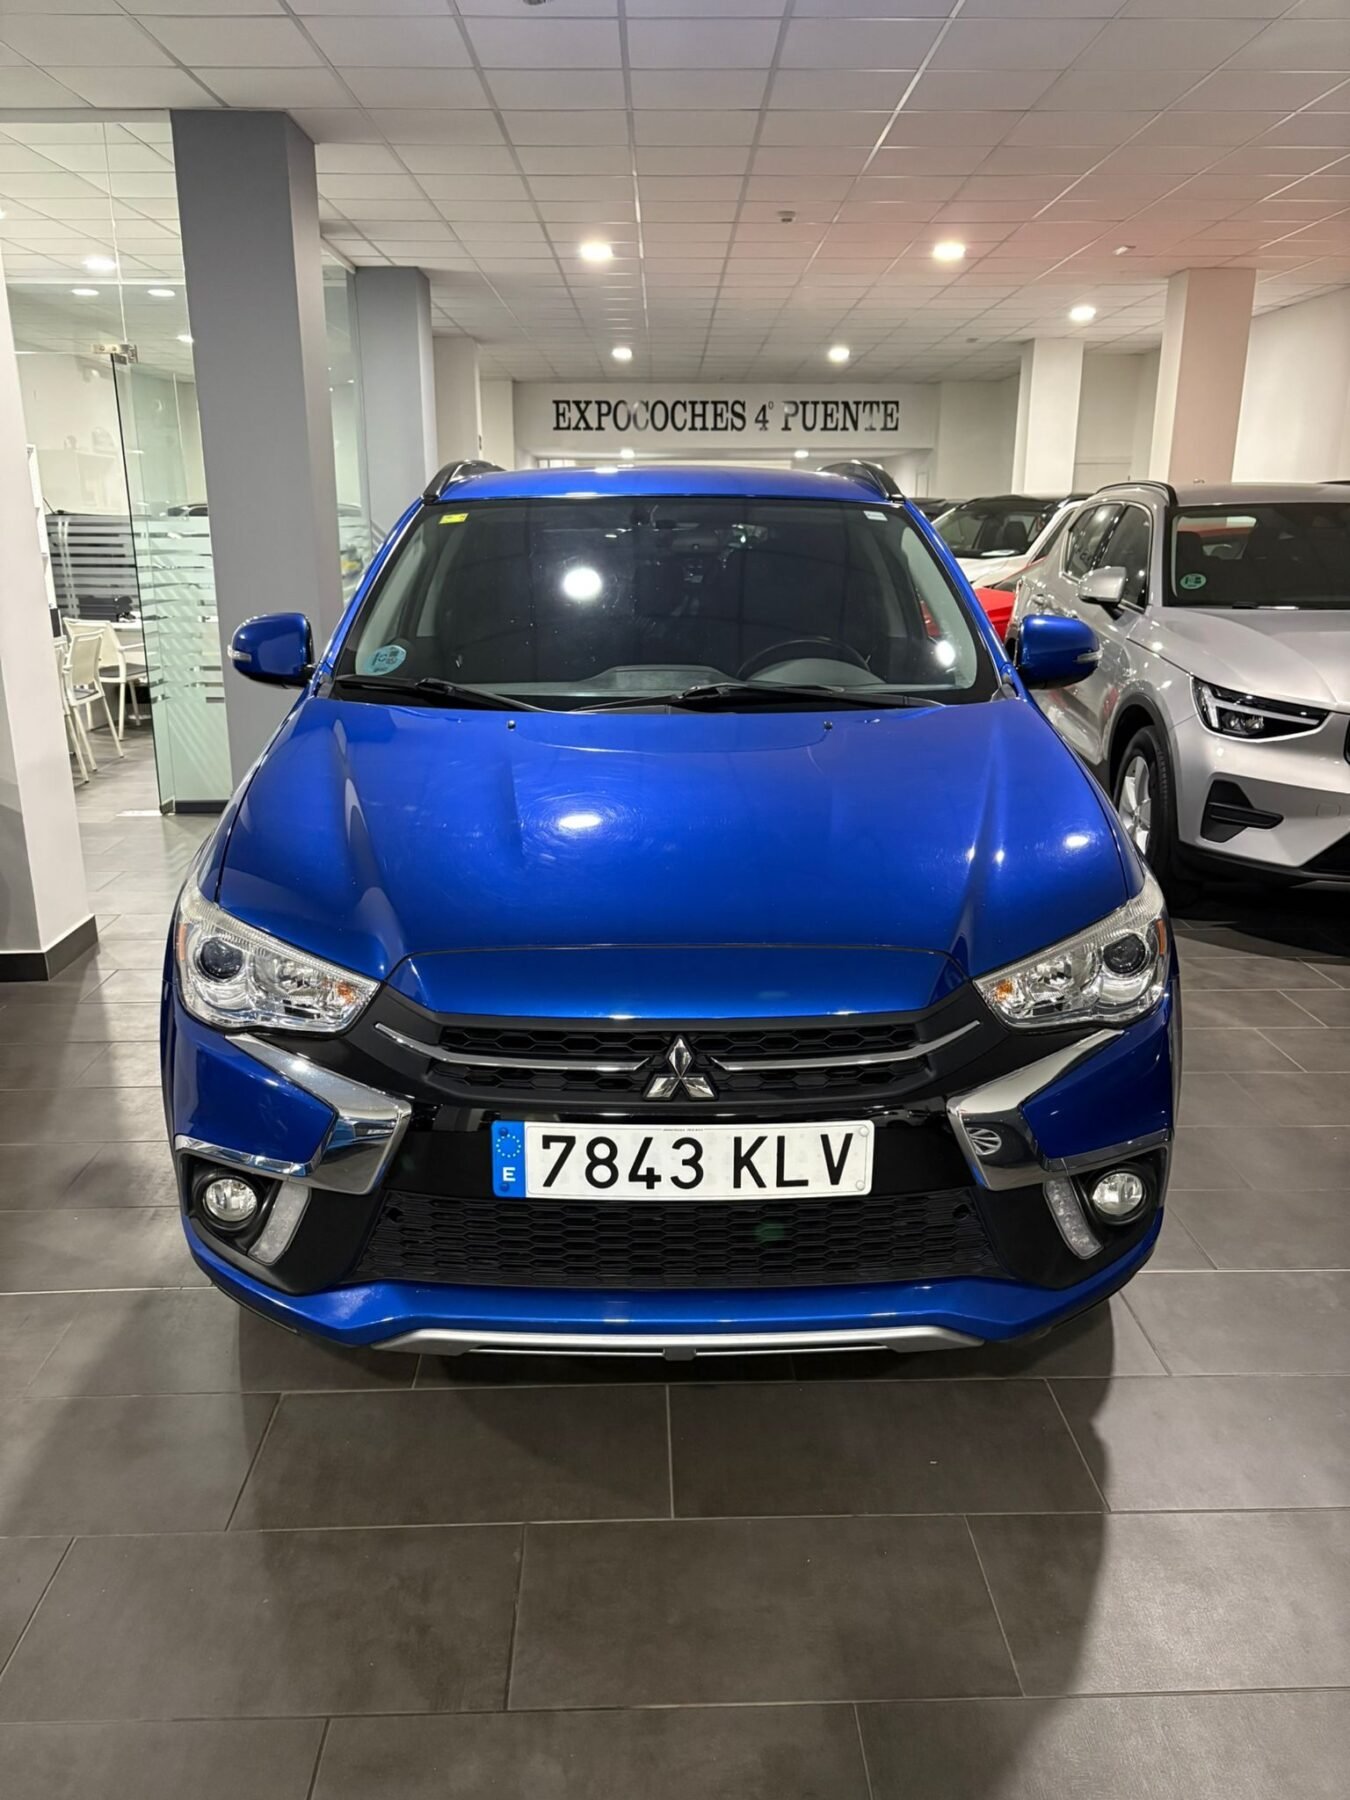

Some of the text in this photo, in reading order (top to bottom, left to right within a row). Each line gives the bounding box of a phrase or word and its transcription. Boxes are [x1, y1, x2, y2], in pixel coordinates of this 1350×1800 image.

[552, 400, 747, 431] EXPOCOCHES
[781, 400, 900, 431] PUENTE
[503, 1167, 516, 1181] E
[541, 1133, 854, 1189] 7843 KLV
